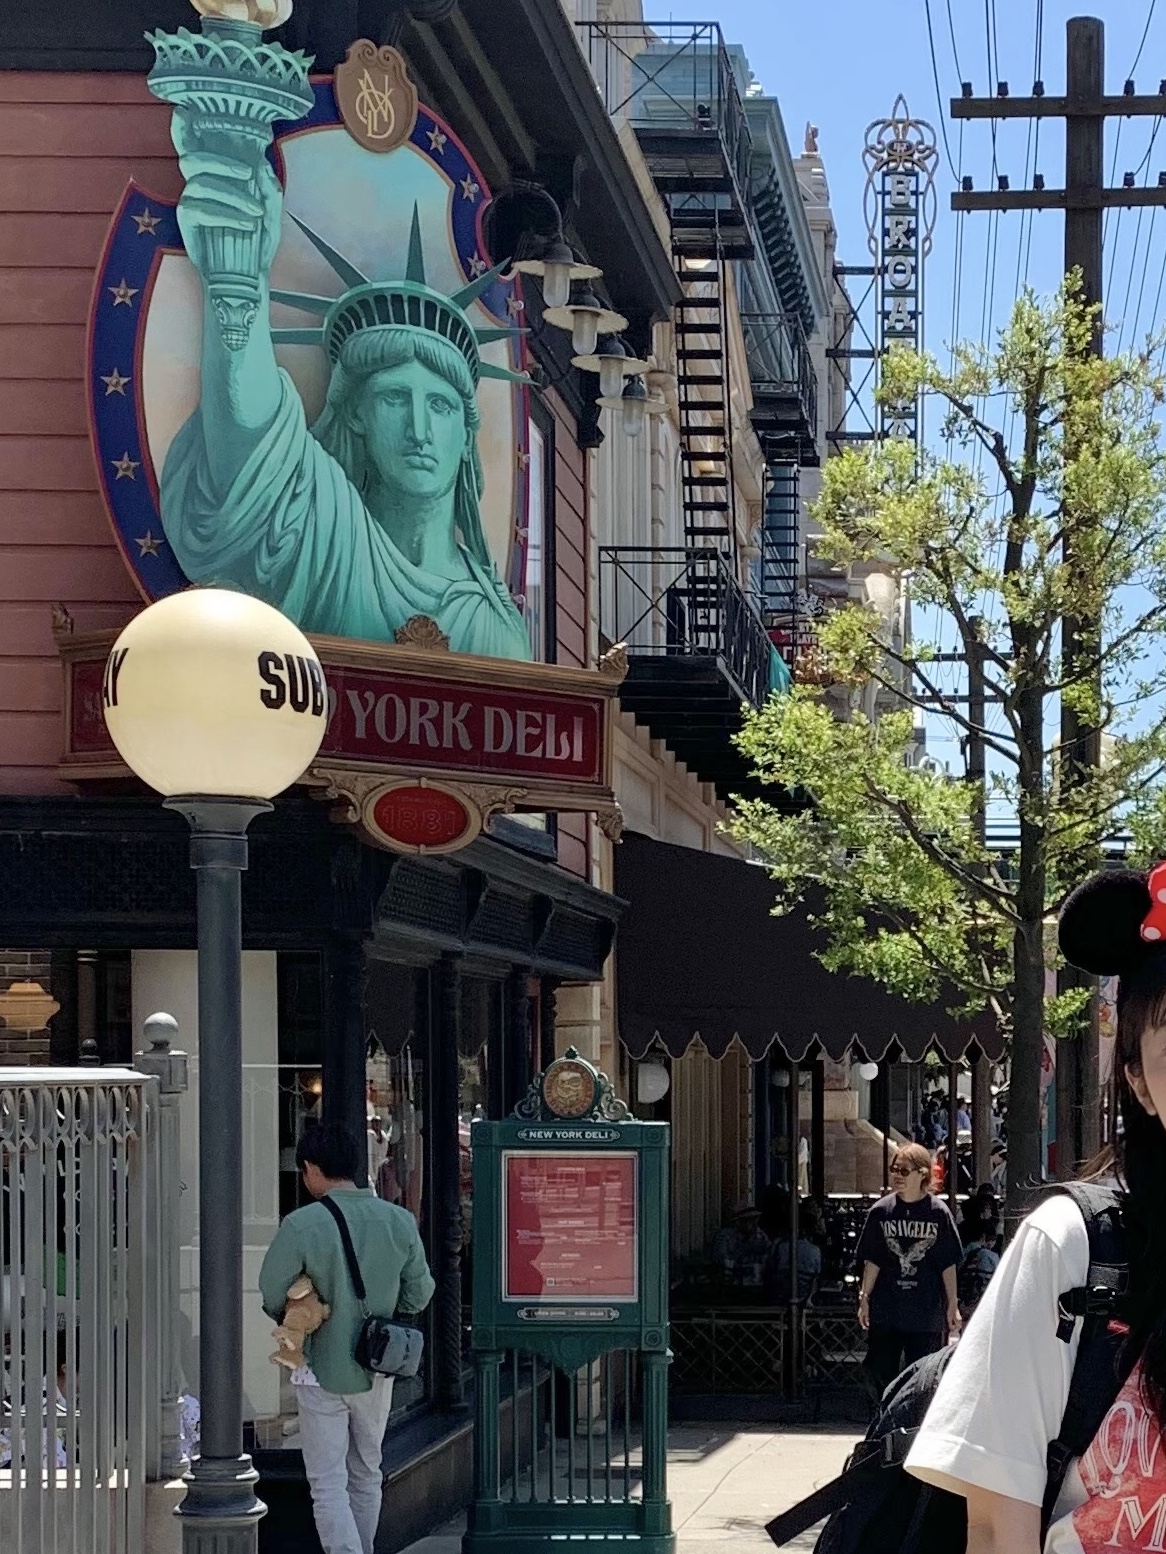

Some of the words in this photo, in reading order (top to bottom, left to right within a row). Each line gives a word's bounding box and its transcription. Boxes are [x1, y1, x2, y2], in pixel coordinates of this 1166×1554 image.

[257, 650, 325, 717] SUB
[346, 689, 473, 751] YORK
[483, 705, 584, 763] DELI
[529, 1130, 554, 1139] NEW
[555, 1130, 583, 1139] YORK
[584, 1130, 609, 1139] DELI
